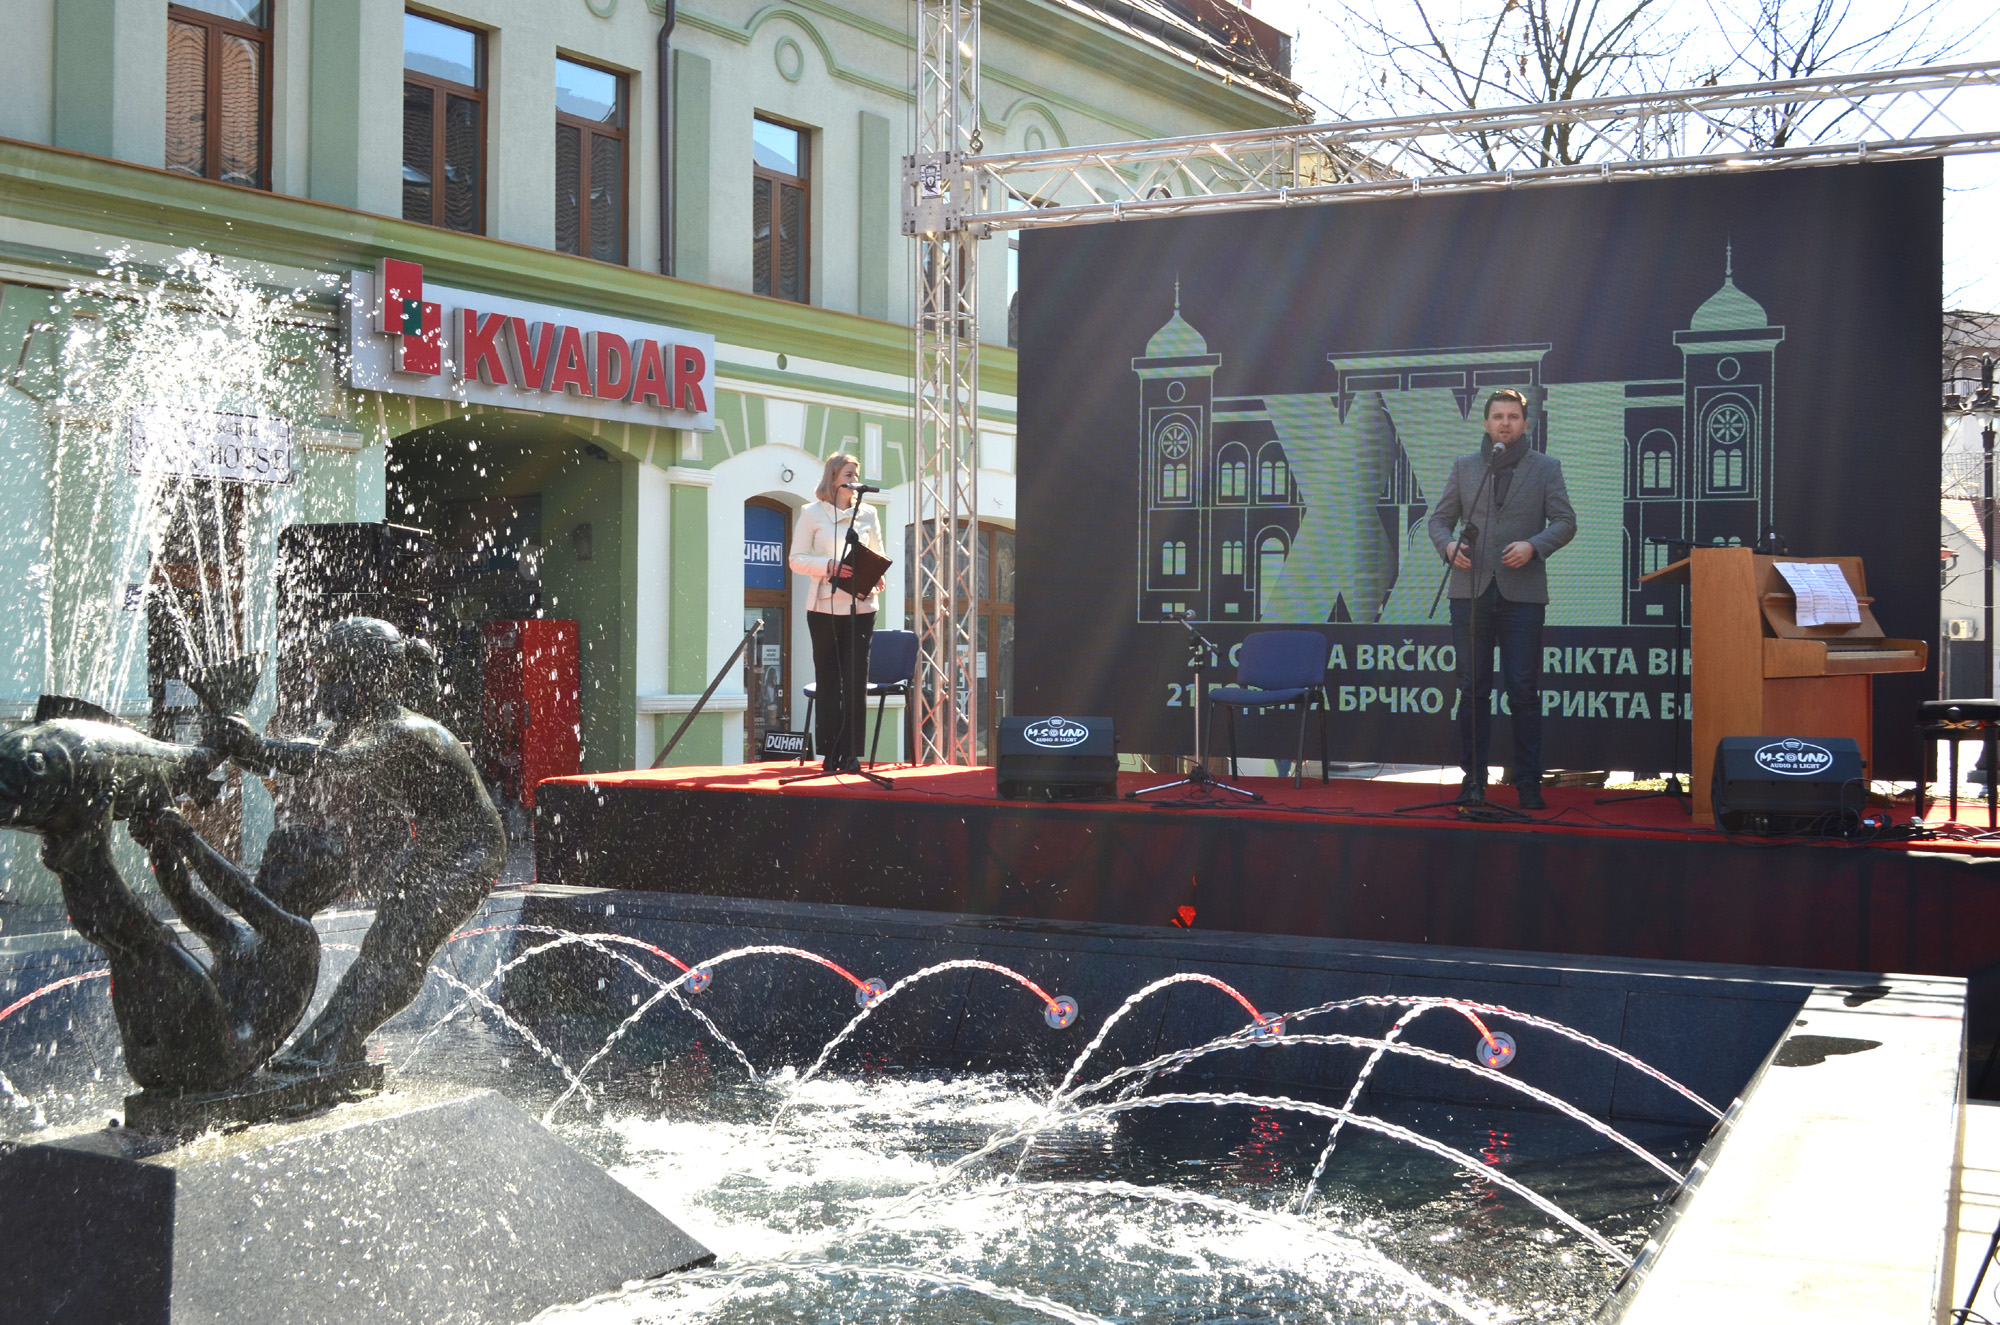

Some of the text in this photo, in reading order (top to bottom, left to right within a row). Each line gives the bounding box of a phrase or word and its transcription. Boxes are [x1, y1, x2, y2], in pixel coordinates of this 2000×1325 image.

[457, 307, 708, 413] KVADAR
[744, 543, 781, 562] UHAN
[1356, 638, 1457, 672] BRČKO
[1470, 646, 1639, 676] IRIKTA
[1166, 682, 1196, 708] 21
[1338, 685, 1444, 715] БРЧКО
[1027, 728, 1086, 738] M-SOUND
[766, 735, 804, 751] DUHAN
[1759, 752, 1829, 763] M-SOUND
